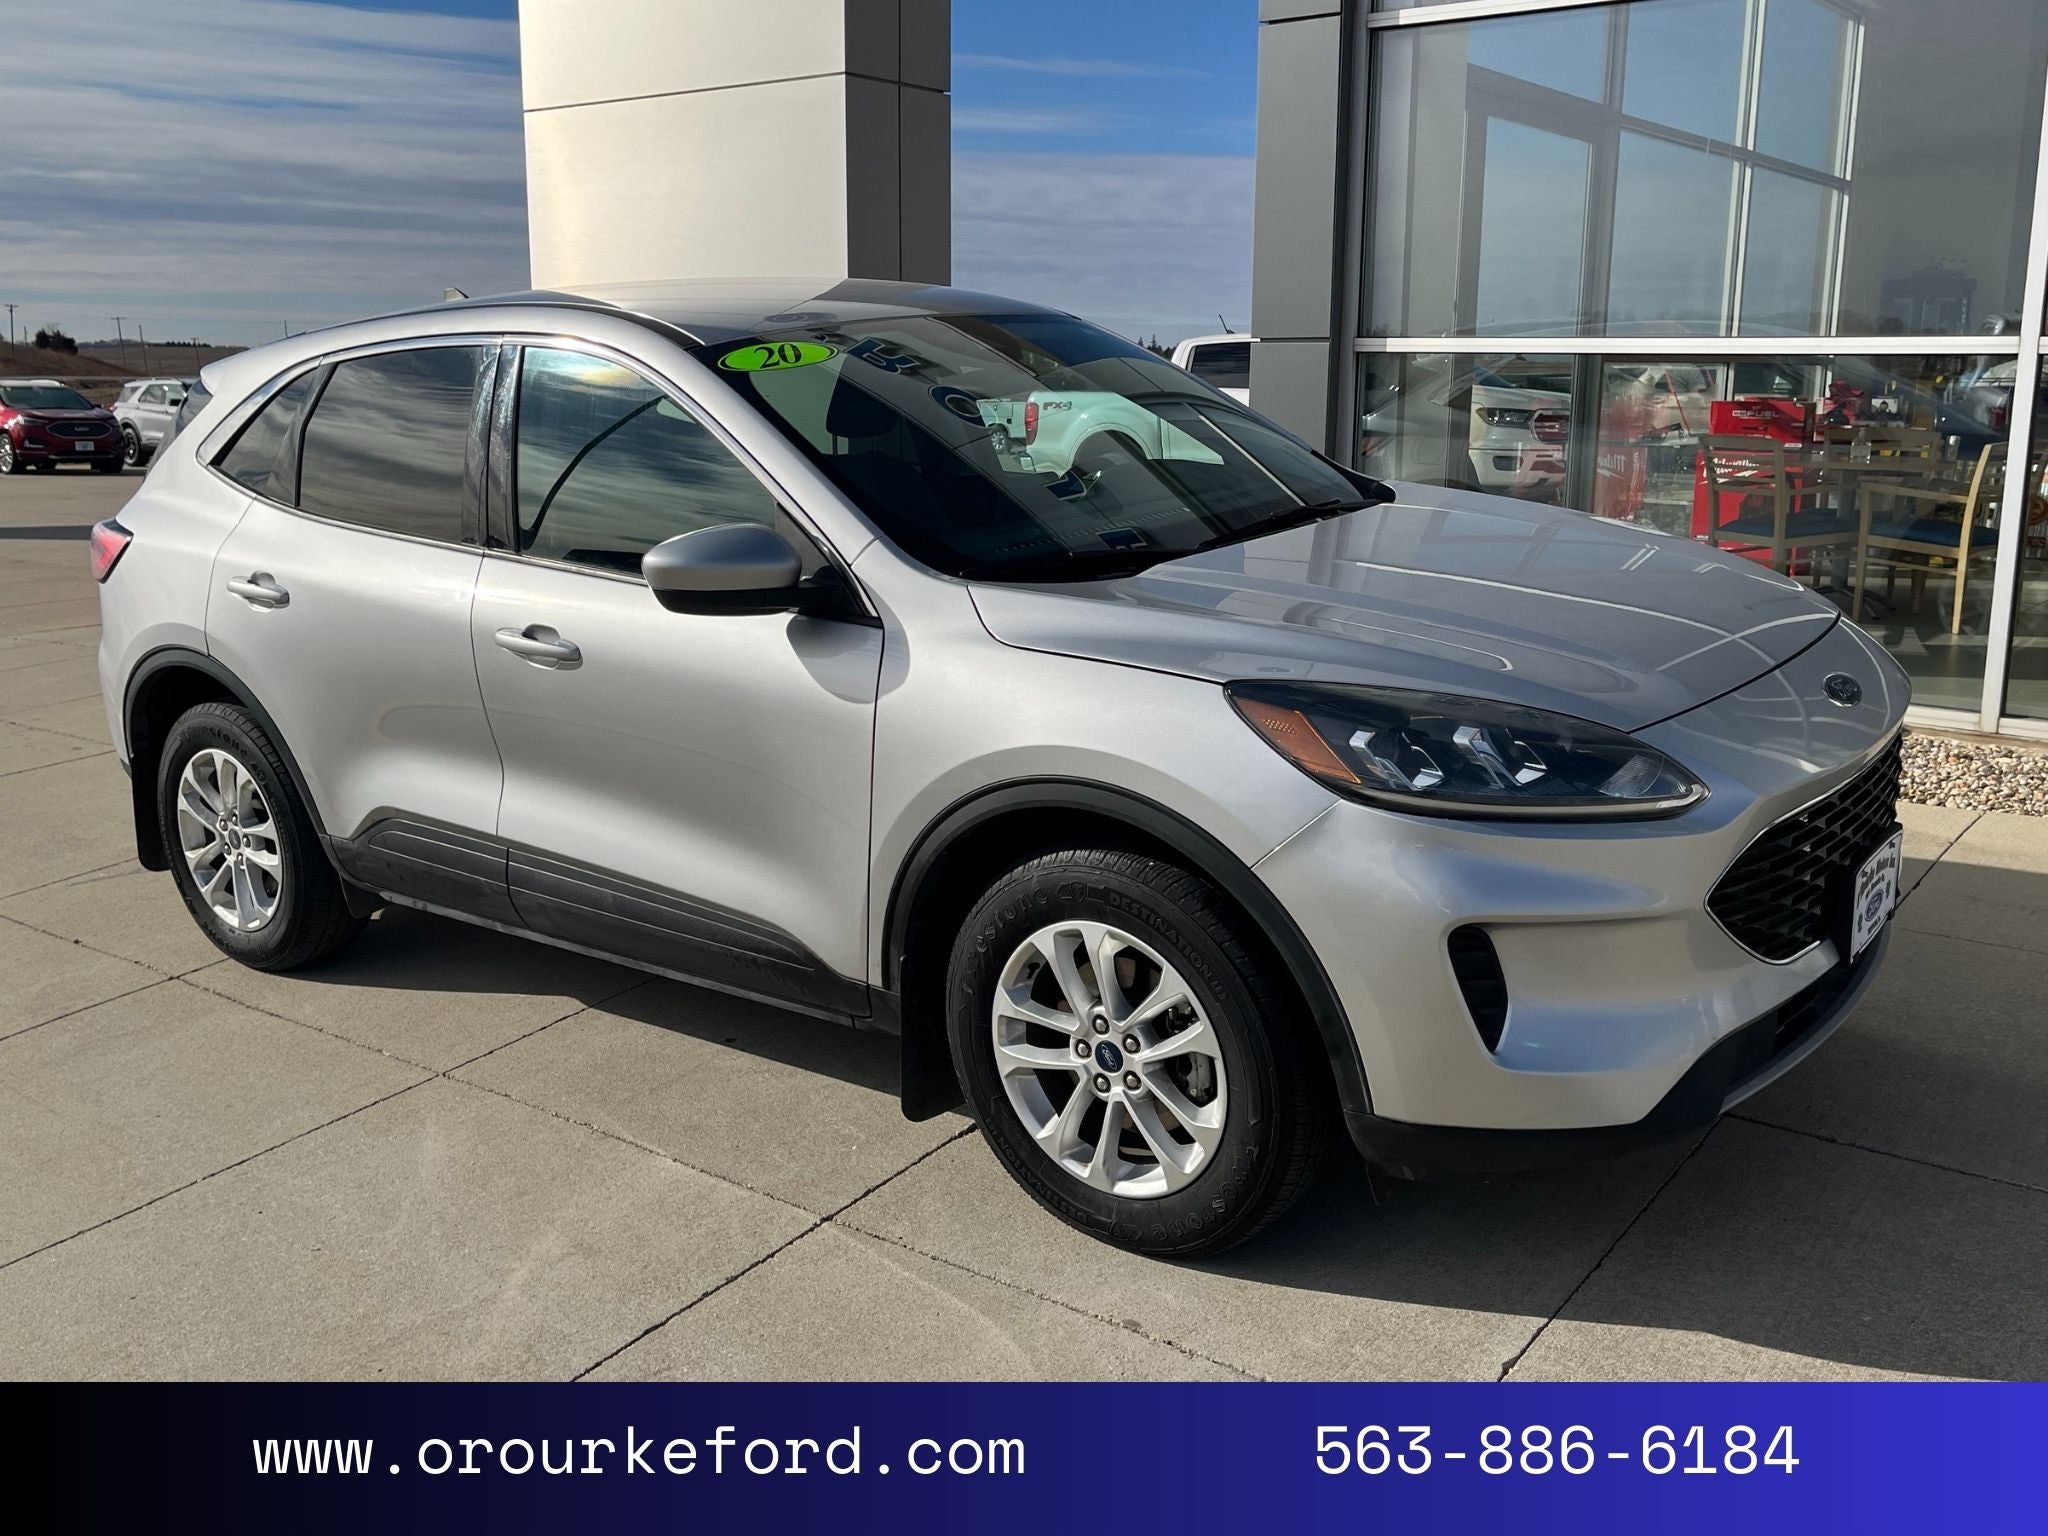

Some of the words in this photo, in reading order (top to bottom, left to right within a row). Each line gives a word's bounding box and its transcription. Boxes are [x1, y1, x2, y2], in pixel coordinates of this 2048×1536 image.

[753, 342, 802, 369] 20
[1042, 401, 1073, 411] FX4
[1108, 892, 1211, 979] DESTINATION
